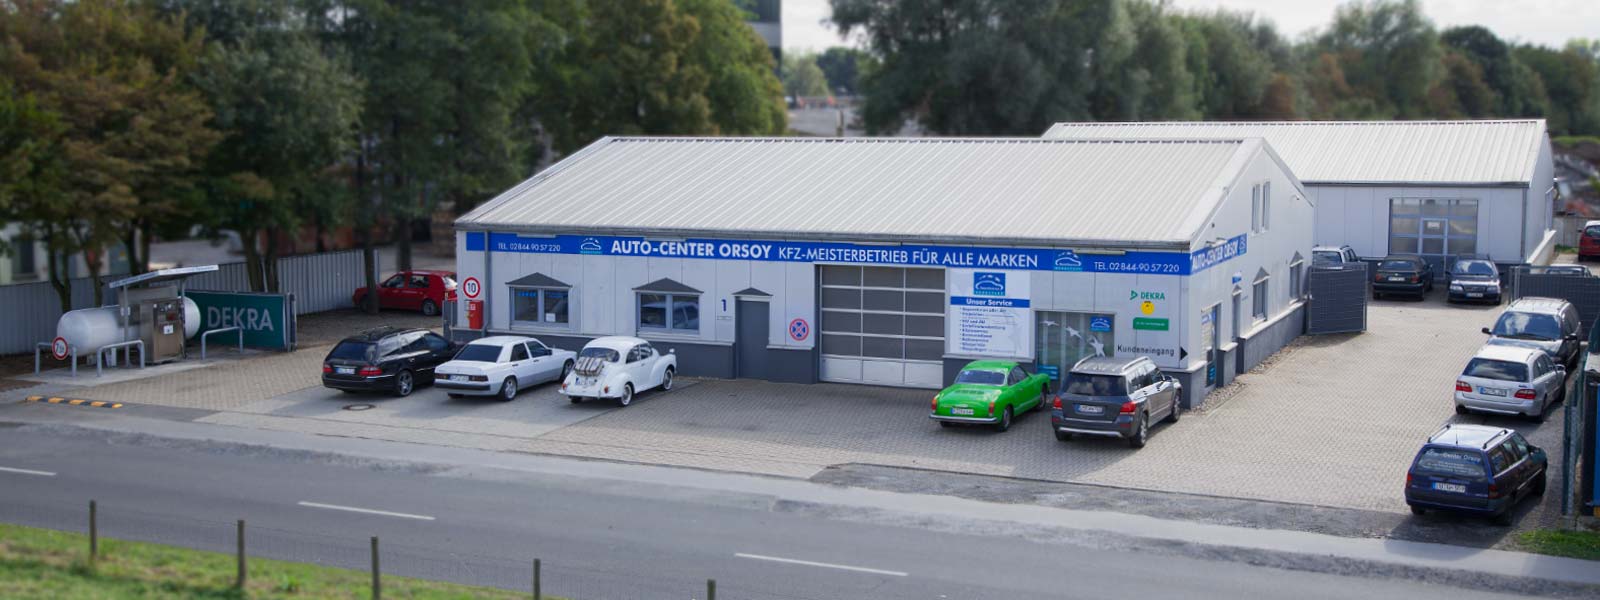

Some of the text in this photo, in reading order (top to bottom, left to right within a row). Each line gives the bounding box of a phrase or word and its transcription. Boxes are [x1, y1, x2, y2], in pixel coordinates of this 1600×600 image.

[611, 240, 1038, 268] AUTO-CENTER ORSOY KFZ-MEISTERBETRIEB FÜR ALLE MARKEN
[1163, 263, 1180, 273] 220
[467, 282, 477, 293] 10
[1140, 291, 1166, 301] DEKRA
[966, 298, 1013, 307] Unser Service
[207, 306, 275, 331] DEKRA
[1117, 345, 1175, 357] Kundeneingang
